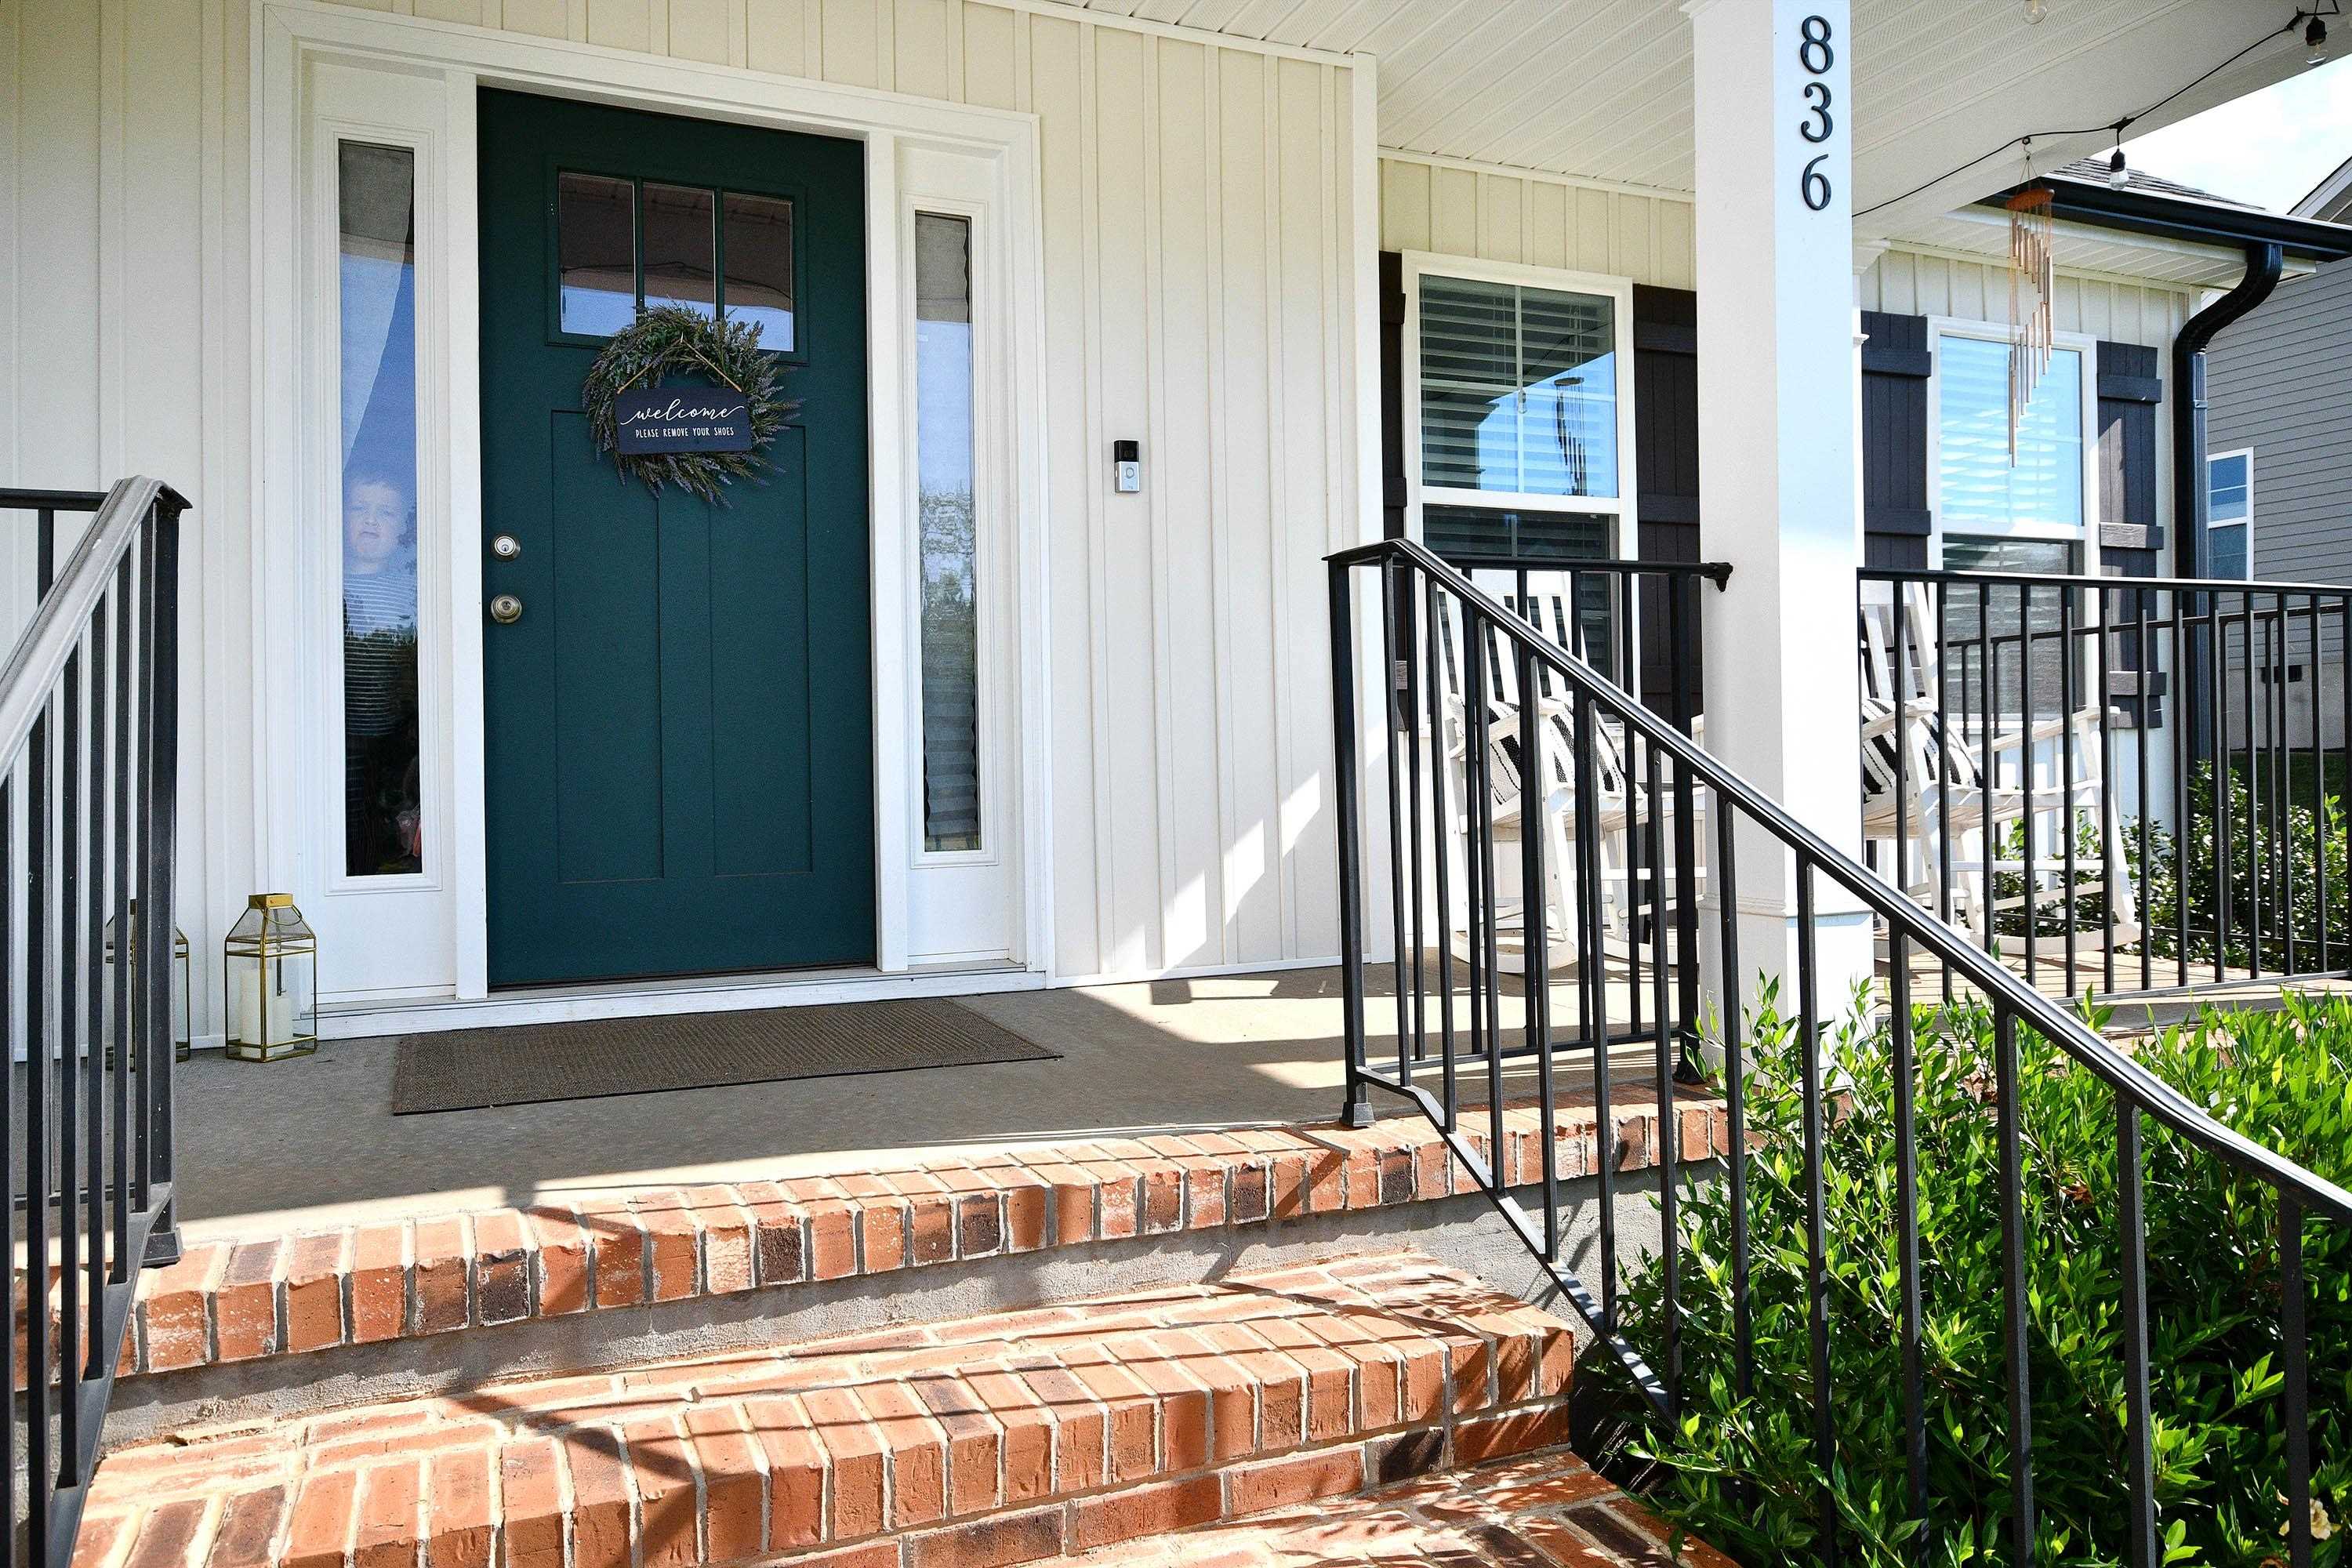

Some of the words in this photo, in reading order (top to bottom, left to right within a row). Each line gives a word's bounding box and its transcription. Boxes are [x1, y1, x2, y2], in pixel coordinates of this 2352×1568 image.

[1800, 15, 1834, 210] 836
[620, 398, 745, 425] welcome
[635, 428, 659, 438] PLEASE
[663, 428, 688, 437] REMOVE
[692, 427, 710, 437] YOUR
[713, 426, 735, 436] SHOES
